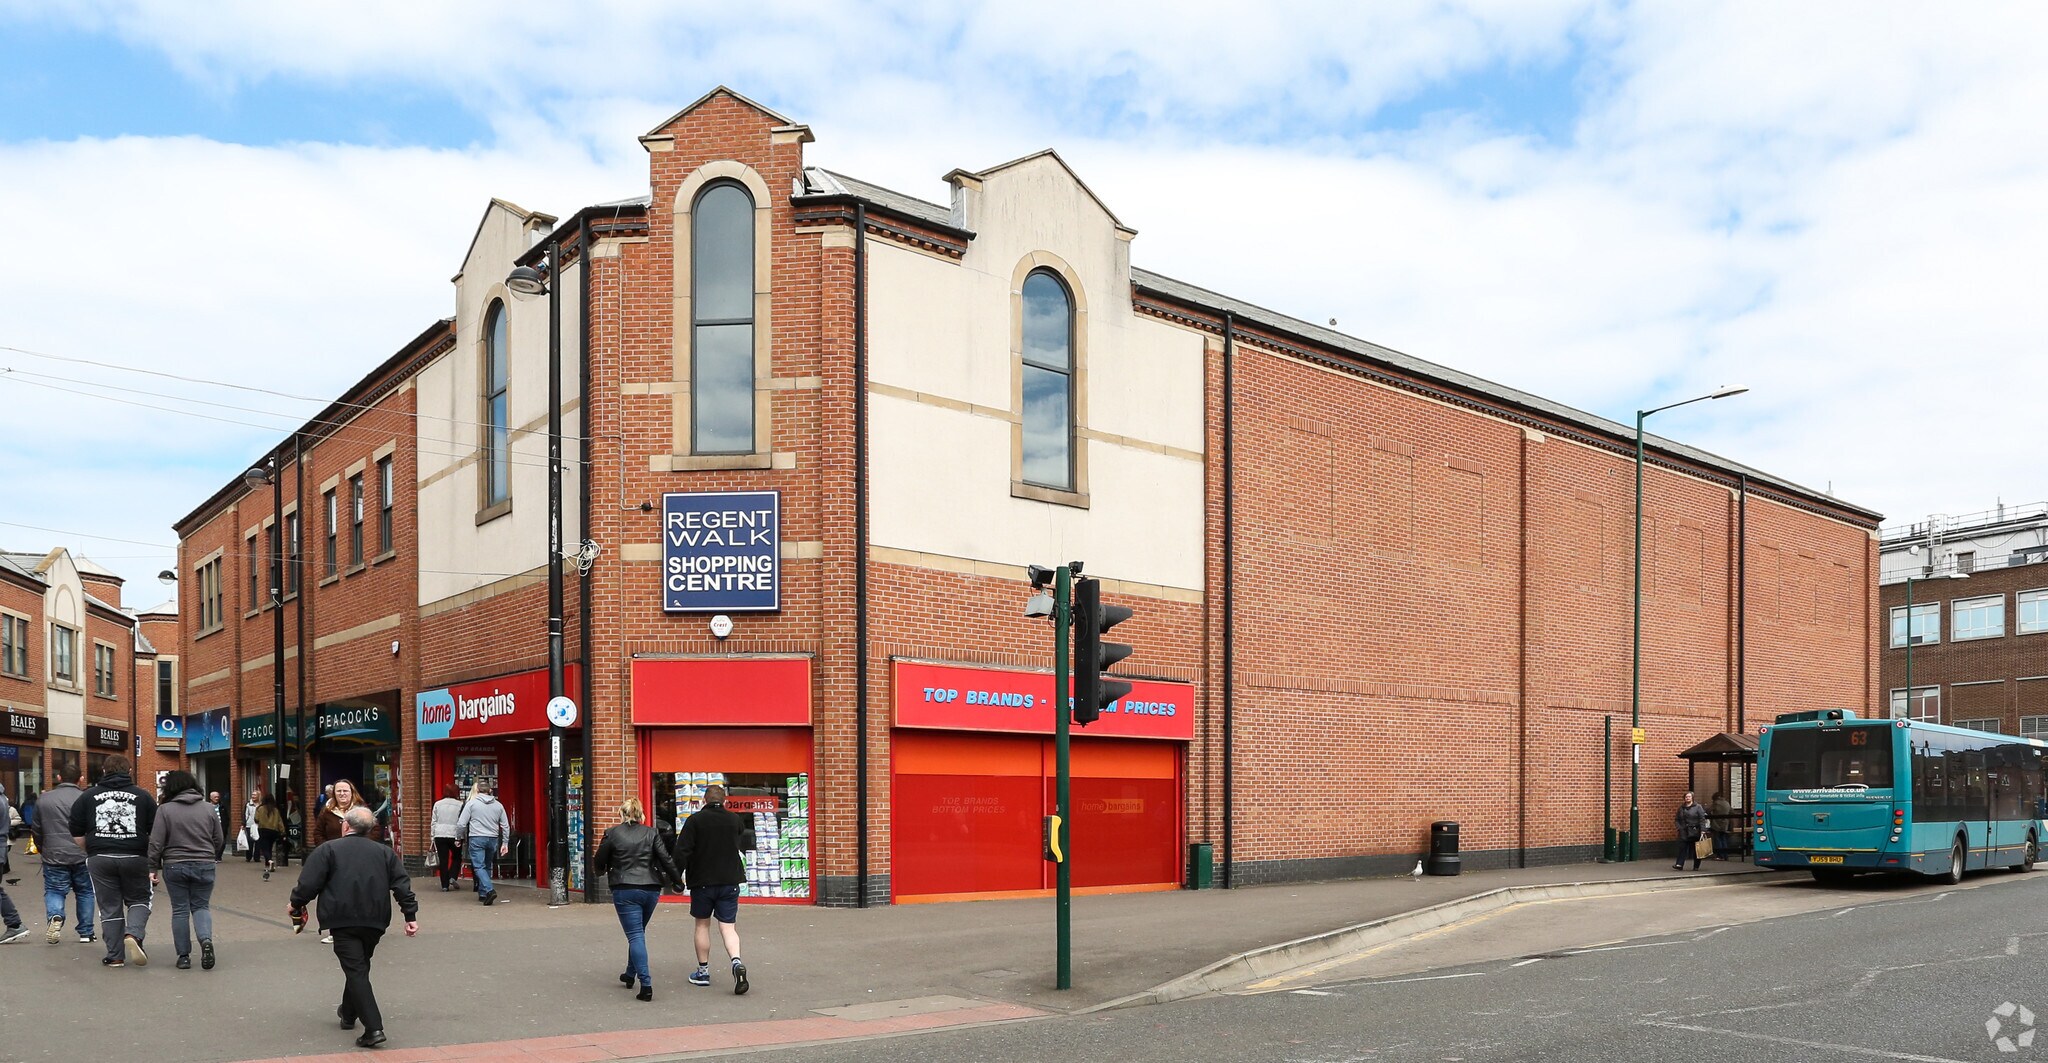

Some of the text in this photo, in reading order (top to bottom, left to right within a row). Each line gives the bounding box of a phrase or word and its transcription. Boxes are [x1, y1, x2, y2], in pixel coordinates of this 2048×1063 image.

[667, 510, 772, 529] REGENT
[668, 529, 772, 547] WALK
[668, 555, 773, 574] SHOPPING
[668, 573, 773, 592] CENTRE
[422, 688, 515, 725] home bargains
[923, 687, 959, 703] TOP
[965, 690, 1034, 708] BRANDS
[1124, 700, 1176, 716] PRICES
[10, 714, 36, 730] BEALES
[319, 706, 379, 729] PEACOCKS
[100, 728, 120, 742] BEALES
[1851, 731, 1867, 746] 63
[93, 790, 137, 801] MONSTER
[963, 797, 999, 805] BRANDS
[1081, 801, 1141, 812] home bargains
